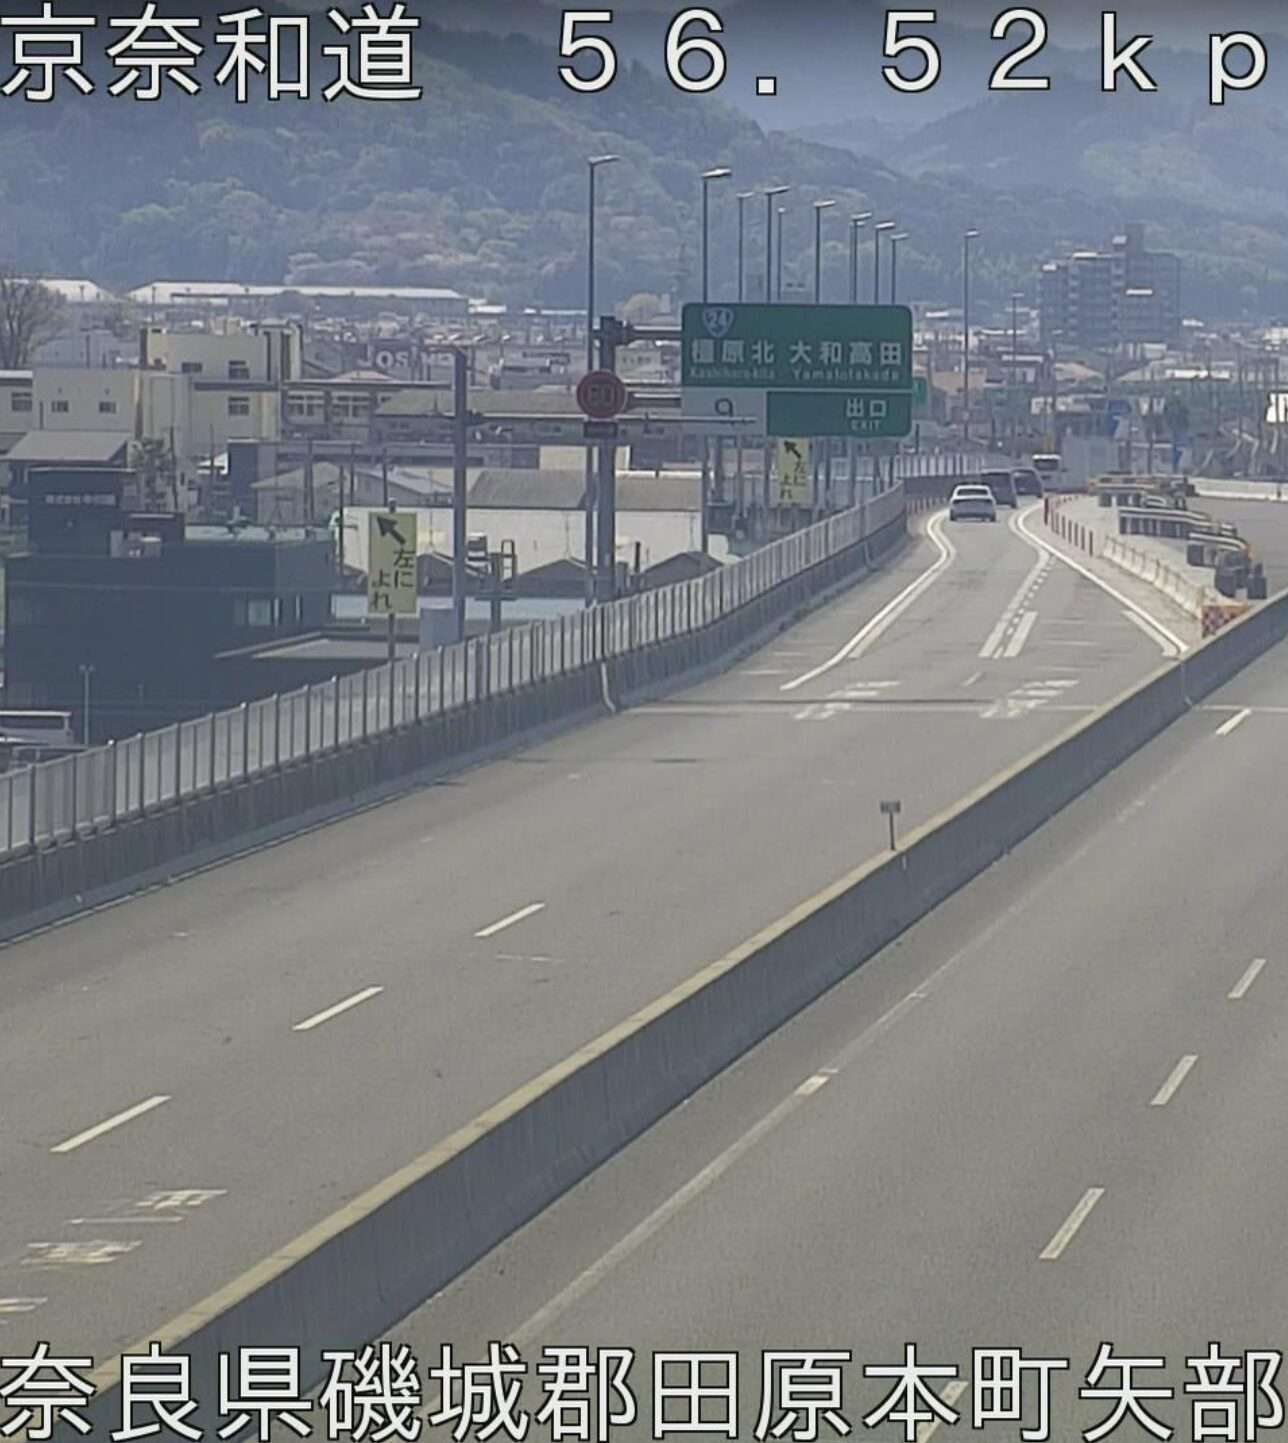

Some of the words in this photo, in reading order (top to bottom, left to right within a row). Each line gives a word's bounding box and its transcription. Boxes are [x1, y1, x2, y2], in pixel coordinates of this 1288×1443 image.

[790, 340, 902, 366] 大和高田
[846, 398, 888, 418] 出口
[851, 419, 881, 431] EXIT
